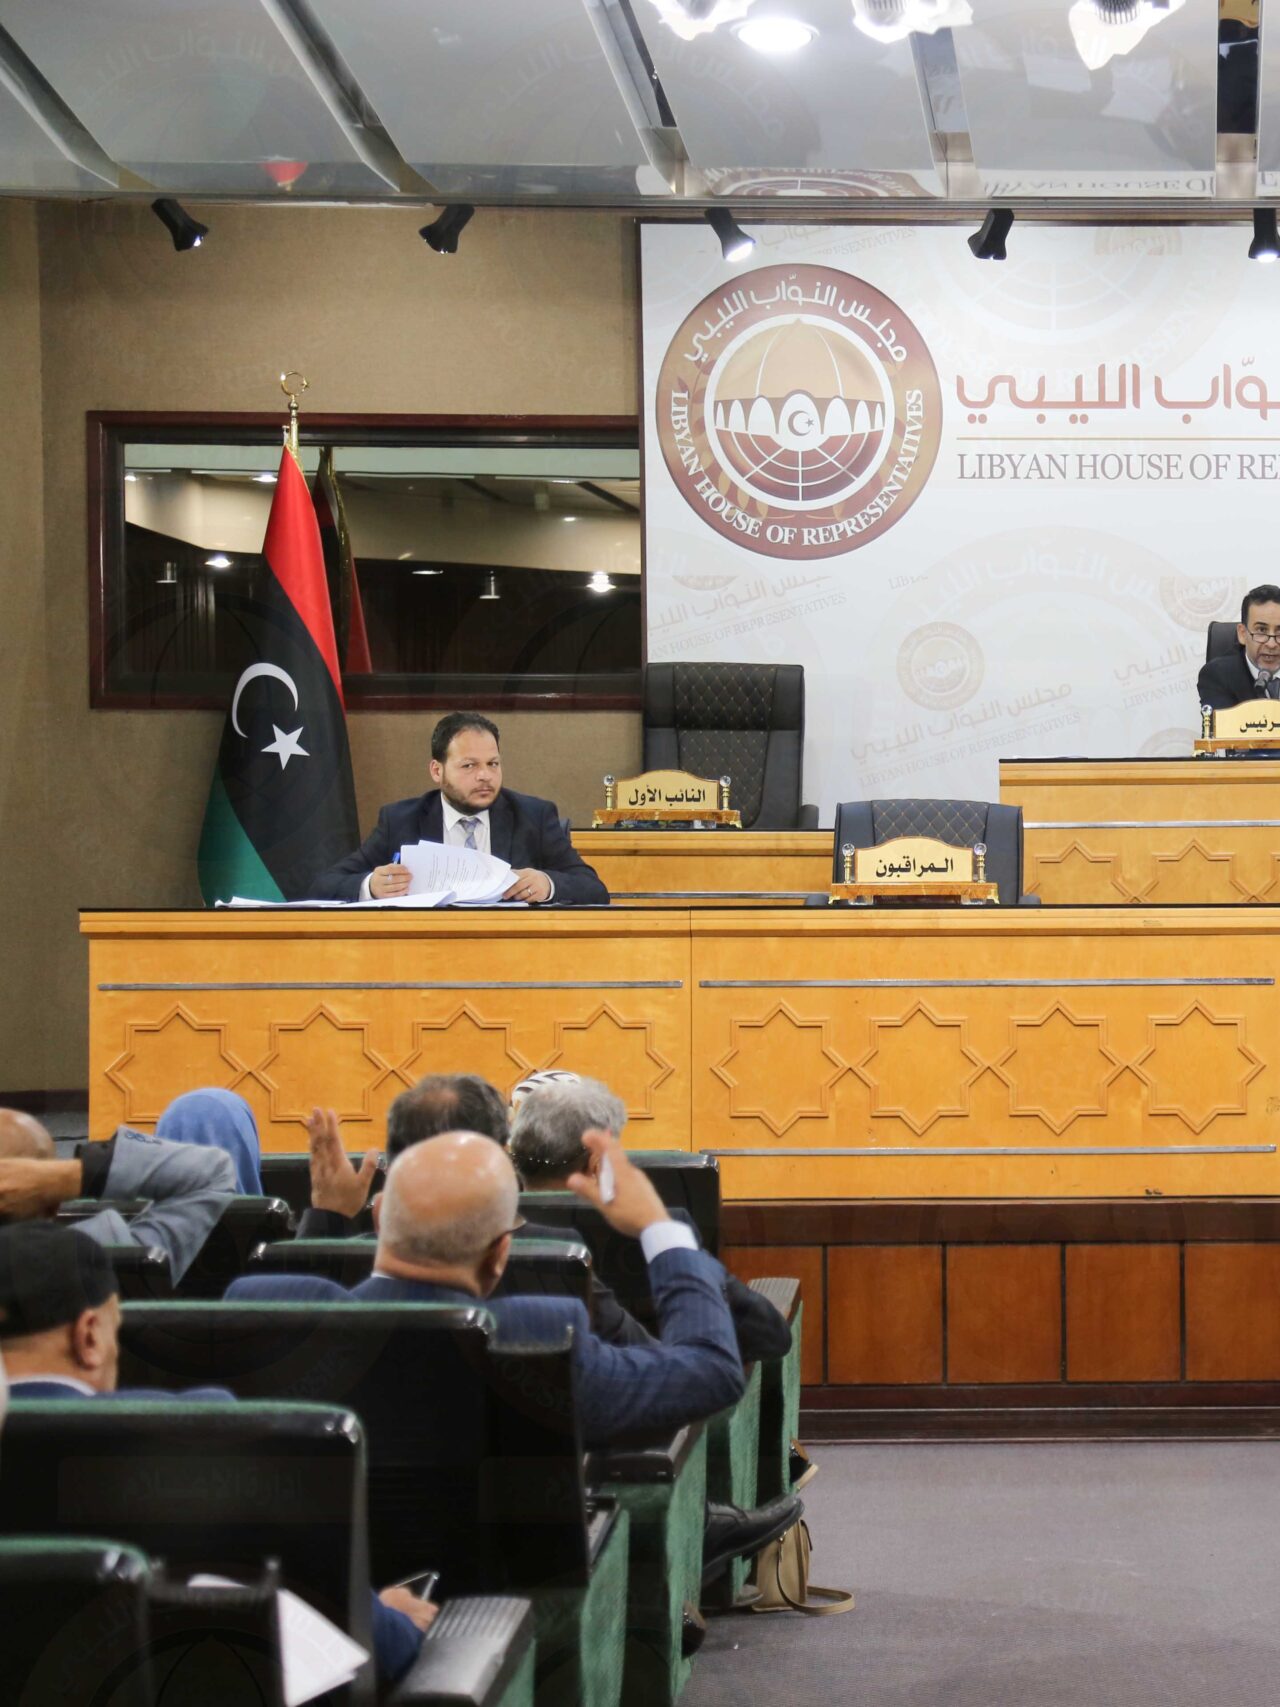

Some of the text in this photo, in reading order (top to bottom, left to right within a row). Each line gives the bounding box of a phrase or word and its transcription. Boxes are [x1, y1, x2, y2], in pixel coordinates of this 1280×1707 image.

[683, 290, 749, 362] الليبي
[838, 299, 908, 362] مجلس
[956, 362, 1141, 425] الليبي
[671, 389, 923, 546] LIBYAN HOUSE OF REPRESENTATIVES
[956, 453, 1070, 481] LIBYAN
[1075, 453, 1184, 481] HOUSE
[1189, 453, 1231, 481] OF
[628, 784, 706, 806] النائب الأول
[875, 855, 954, 878] المراقبون
